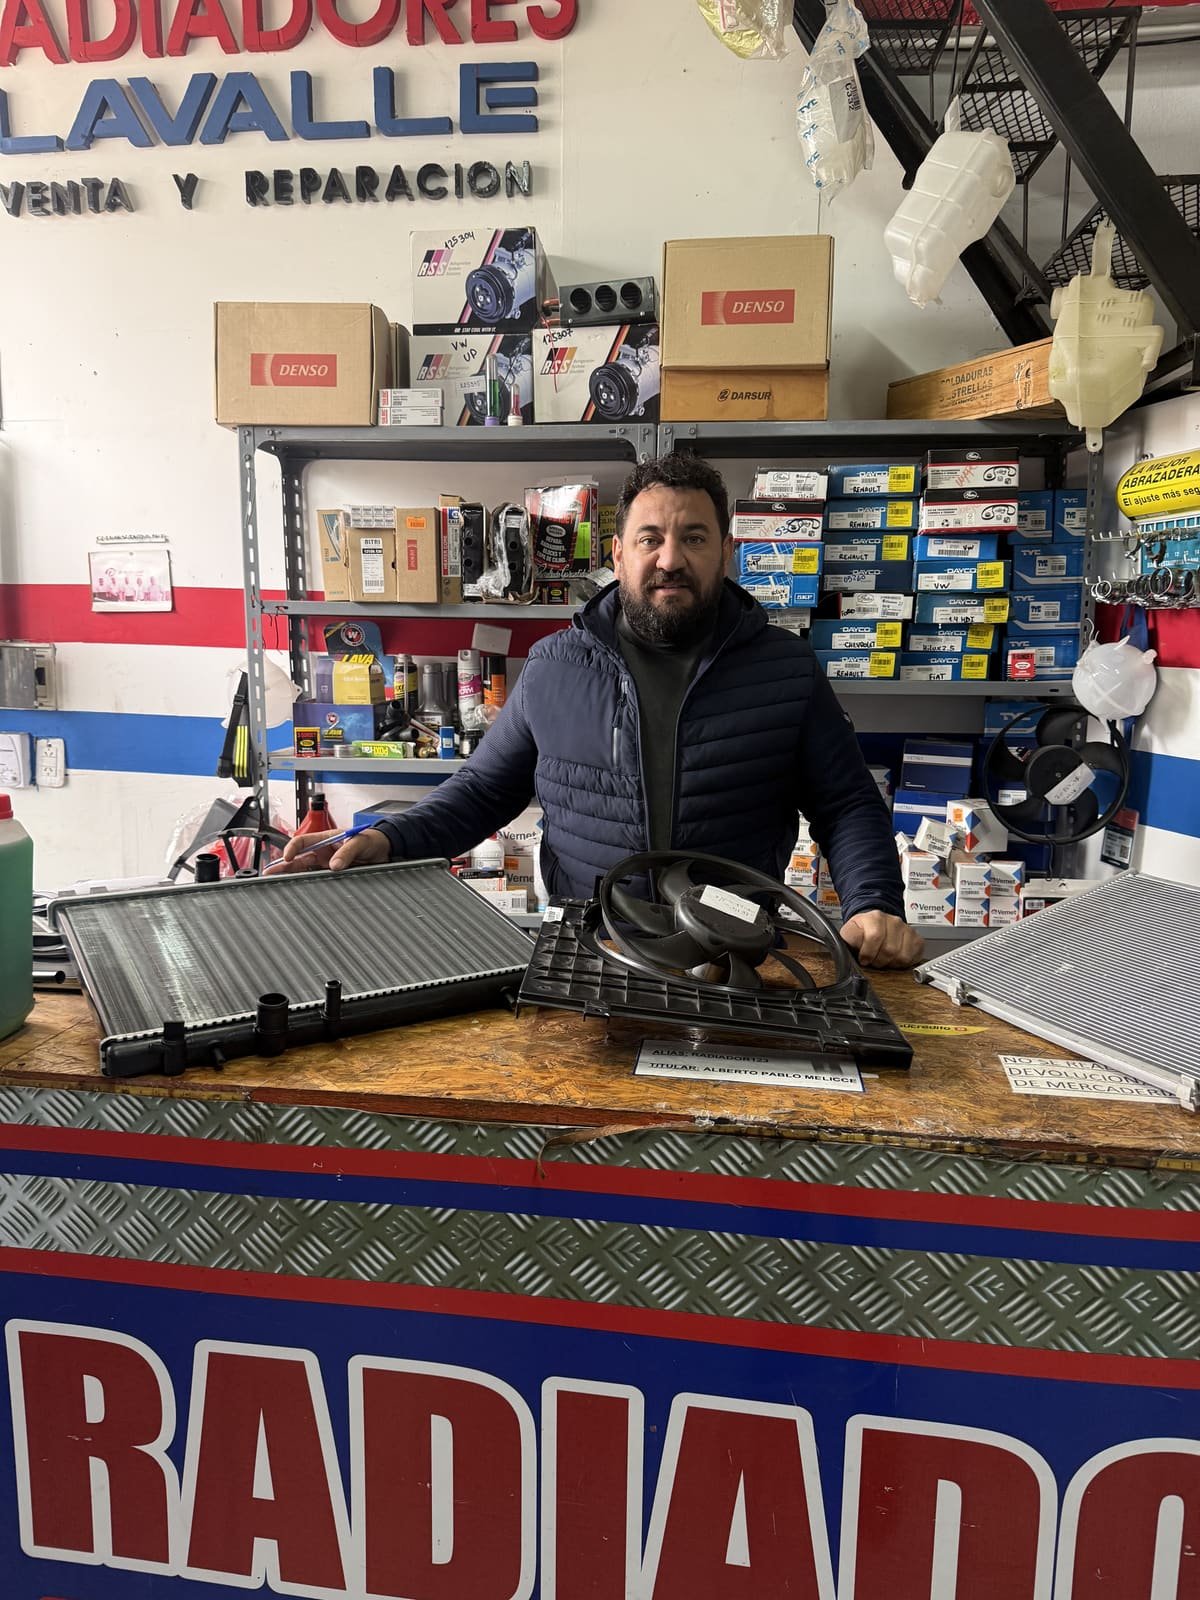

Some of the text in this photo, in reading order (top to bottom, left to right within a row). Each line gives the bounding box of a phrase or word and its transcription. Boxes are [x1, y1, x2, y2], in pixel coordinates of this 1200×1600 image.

[0, 61, 538, 155] LAVALLE
[0, 160, 532, 217] VENTA Y REPARACION
[732, 300, 785, 313] DENSO
[451, 338, 468, 351] VW
[463, 348, 478, 362] UP
[279, 364, 329, 376] DENSO
[731, 391, 772, 400] DARSUR
[1129, 456, 1191, 476] LA MEJOR
[1123, 497, 1131, 506] El
[1134, 493, 1160, 506] ajuste
[1162, 489, 1181, 500] más
[341, 654, 375, 664] LAVA
[691, 1052, 769, 1063] RADIADOR123
[650, 1062, 858, 1084] TITULAR: ALBERTO PABLO MELICCE
[1008, 1068, 1147, 1087] DEVOLUCION
[1014, 1079, 1040, 1088] DE
